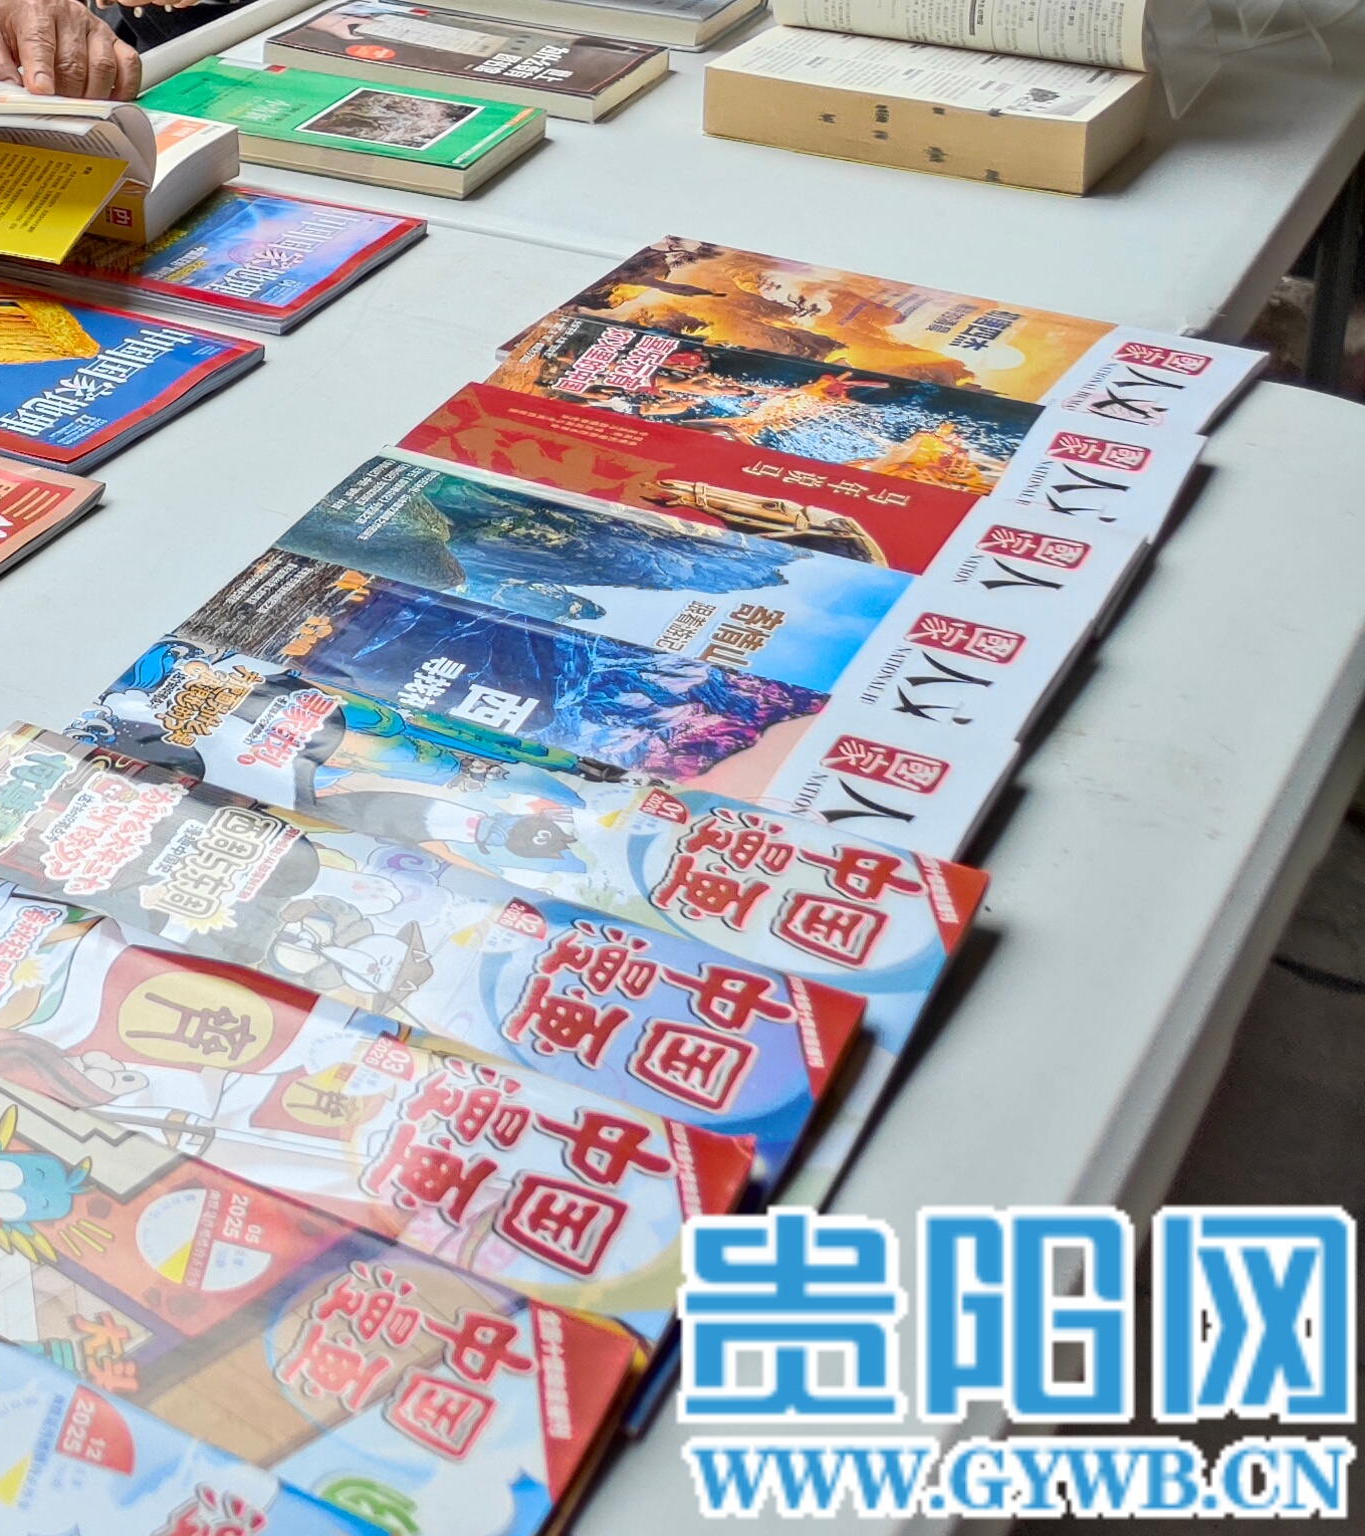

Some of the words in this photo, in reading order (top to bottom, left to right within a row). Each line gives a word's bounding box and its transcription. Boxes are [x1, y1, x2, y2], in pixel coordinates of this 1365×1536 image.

[553, 328, 633, 392] 灯火里的中国
[602, 335, 677, 389] 喜乐元宵
[1113, 340, 1213, 377] 國家
[1087, 366, 1188, 426] 人文
[1045, 429, 1151, 472] 國家
[742, 458, 911, 507] 马年说马
[977, 524, 1091, 571] 國家
[904, 610, 1029, 665] 國家
[821, 733, 953, 795] 國家
[656, 800, 687, 819] 01
[495, 902, 523, 925] 2026
[512, 912, 544, 933] 02
[758, 834, 927, 965] 中国
[504, 923, 659, 1069] 漫画
[363, 1037, 391, 1065] 2026
[379, 1049, 413, 1072] 03
[630, 962, 798, 1114] 中国
[361, 1061, 522, 1222] 漫画
[209, 1193, 258, 1238] 2025
[492, 1107, 677, 1276] 中国
[238, 1222, 265, 1244] 05
[276, 1260, 416, 1414] 漫画
[391, 1311, 536, 1463] 中国
[42, 1399, 112, 1452] 2025
[77, 1436, 114, 1460] 12
